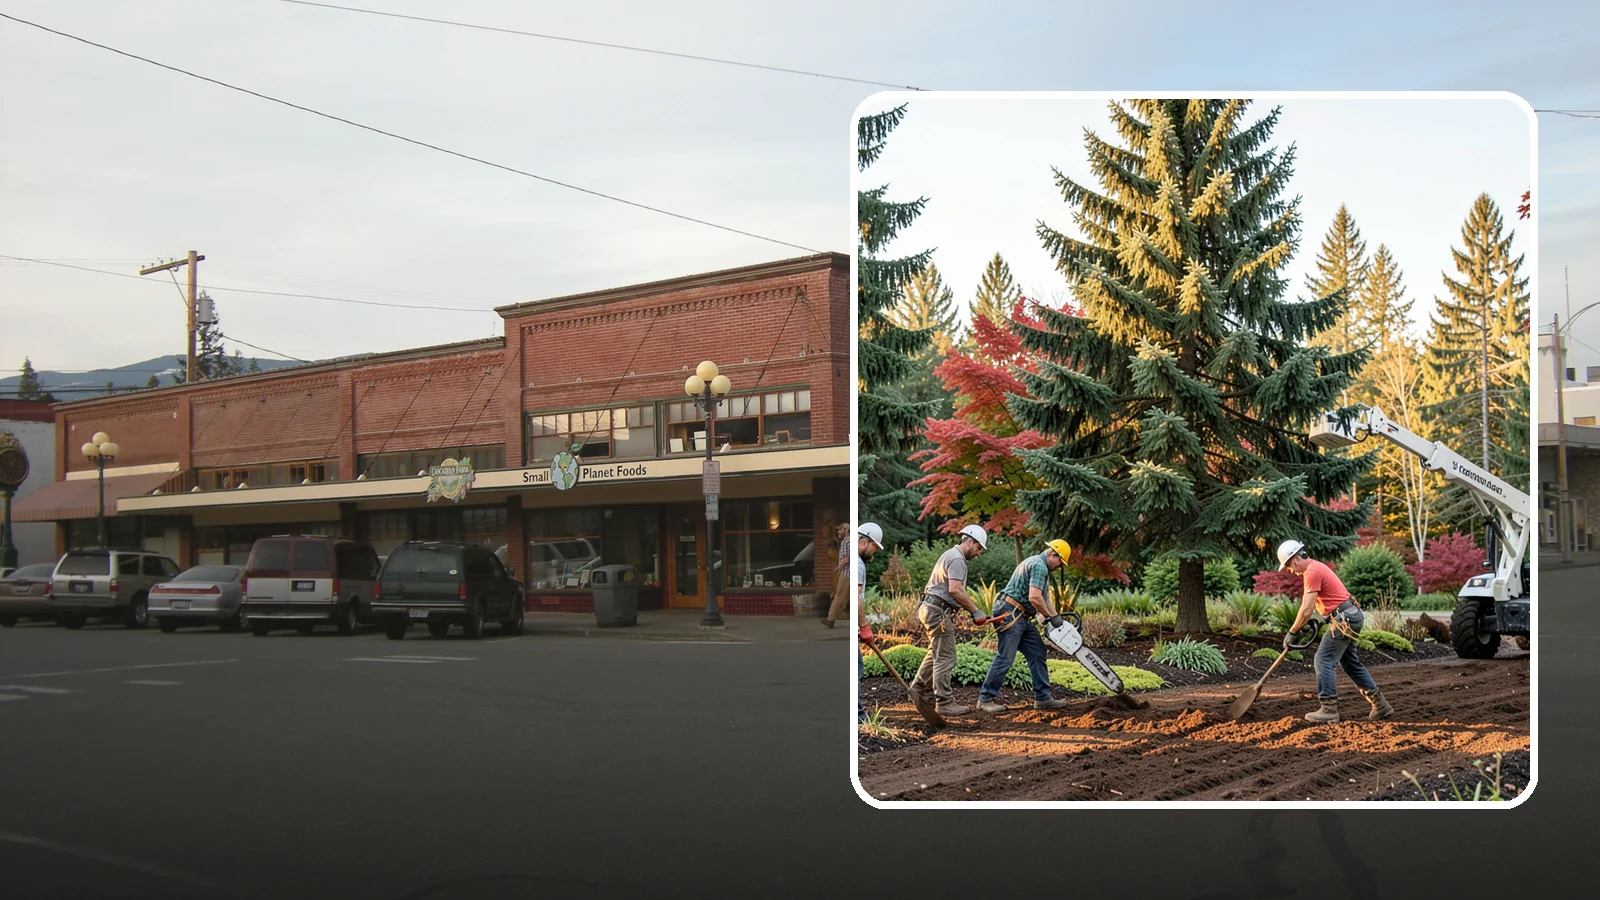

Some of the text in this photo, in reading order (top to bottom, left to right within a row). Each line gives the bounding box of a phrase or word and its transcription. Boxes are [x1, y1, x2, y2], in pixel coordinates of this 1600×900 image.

[523, 464, 647, 483] Small Planet Foods
